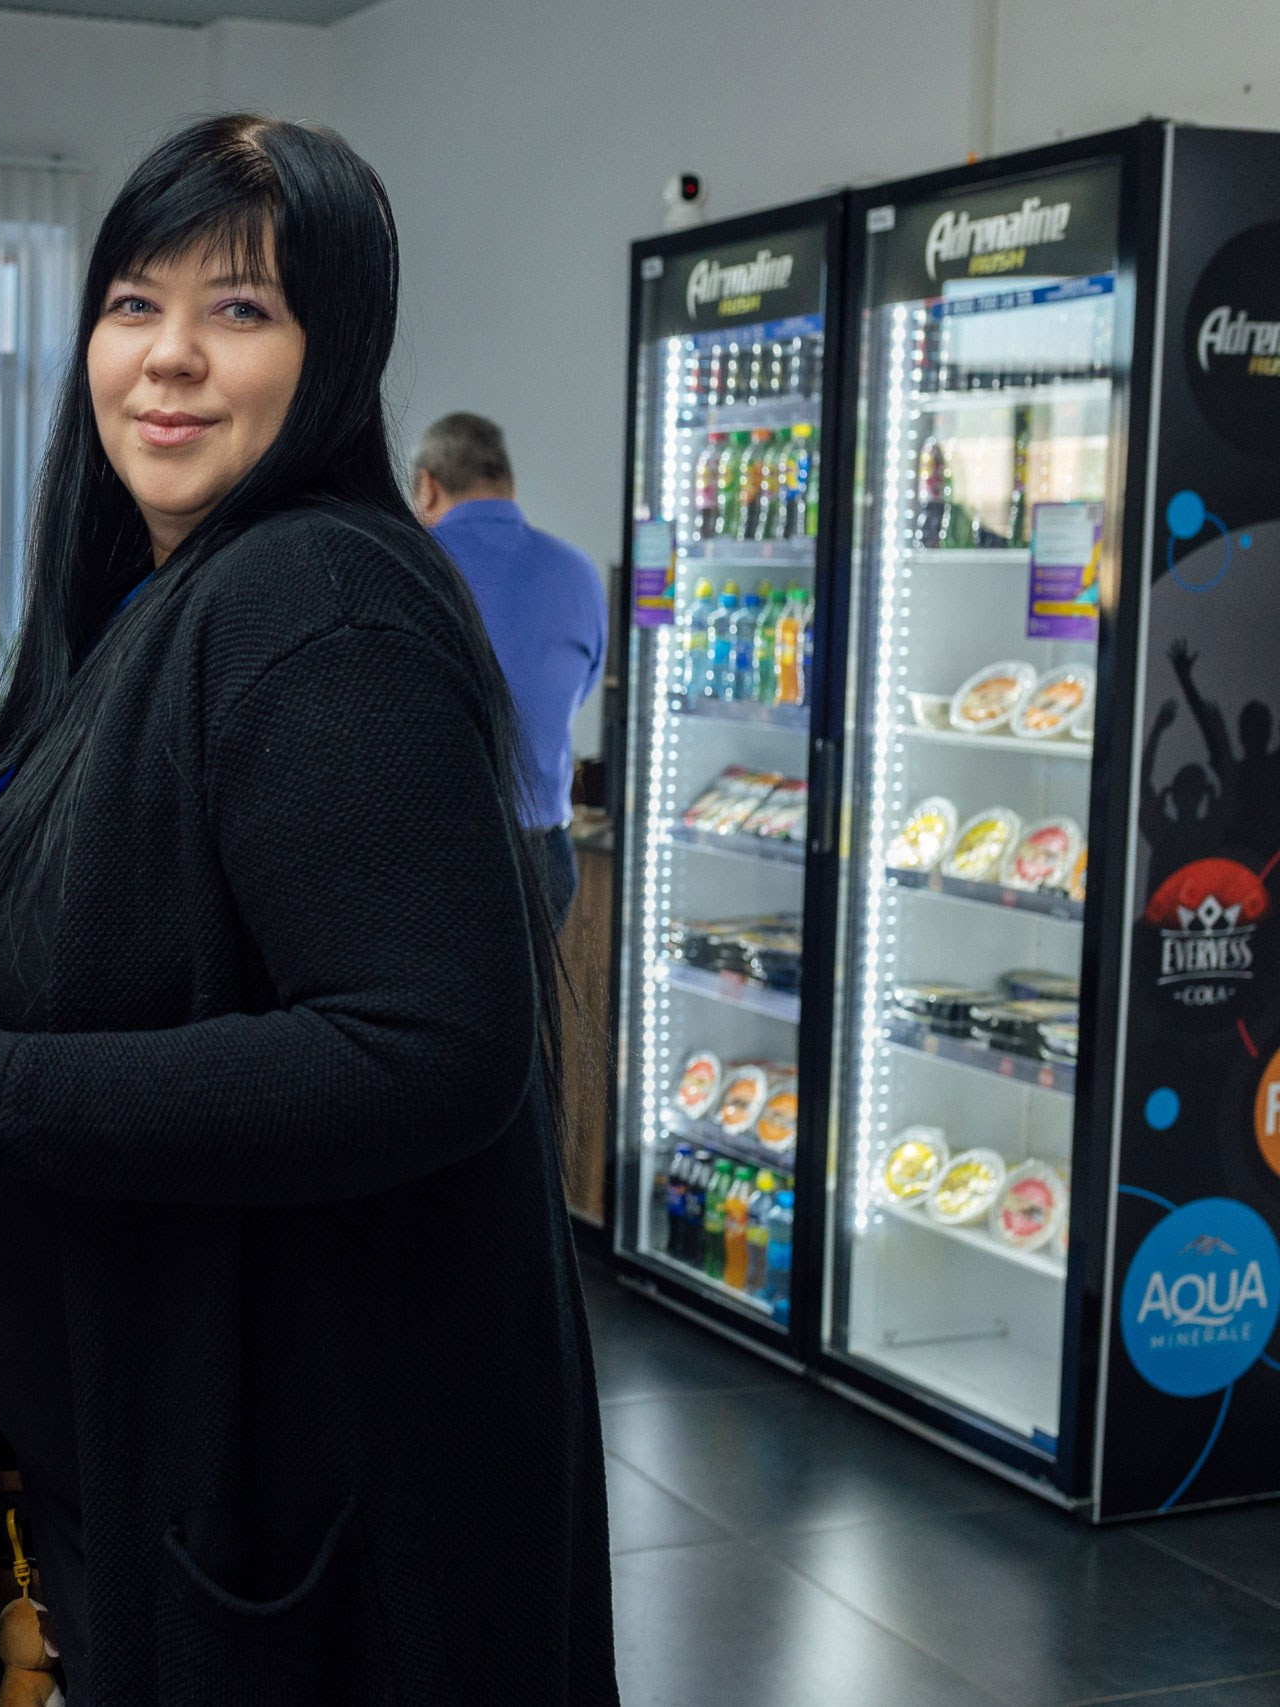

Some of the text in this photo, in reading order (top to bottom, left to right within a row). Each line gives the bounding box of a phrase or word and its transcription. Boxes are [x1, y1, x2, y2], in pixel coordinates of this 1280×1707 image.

[925, 197, 1071, 281] Adrenaline
[687, 250, 794, 320] Adrenaline
[1181, 985, 1228, 1006] COLA
[1136, 1260, 1269, 1327] AQUA
[1149, 1321, 1253, 1349] MINERALE
